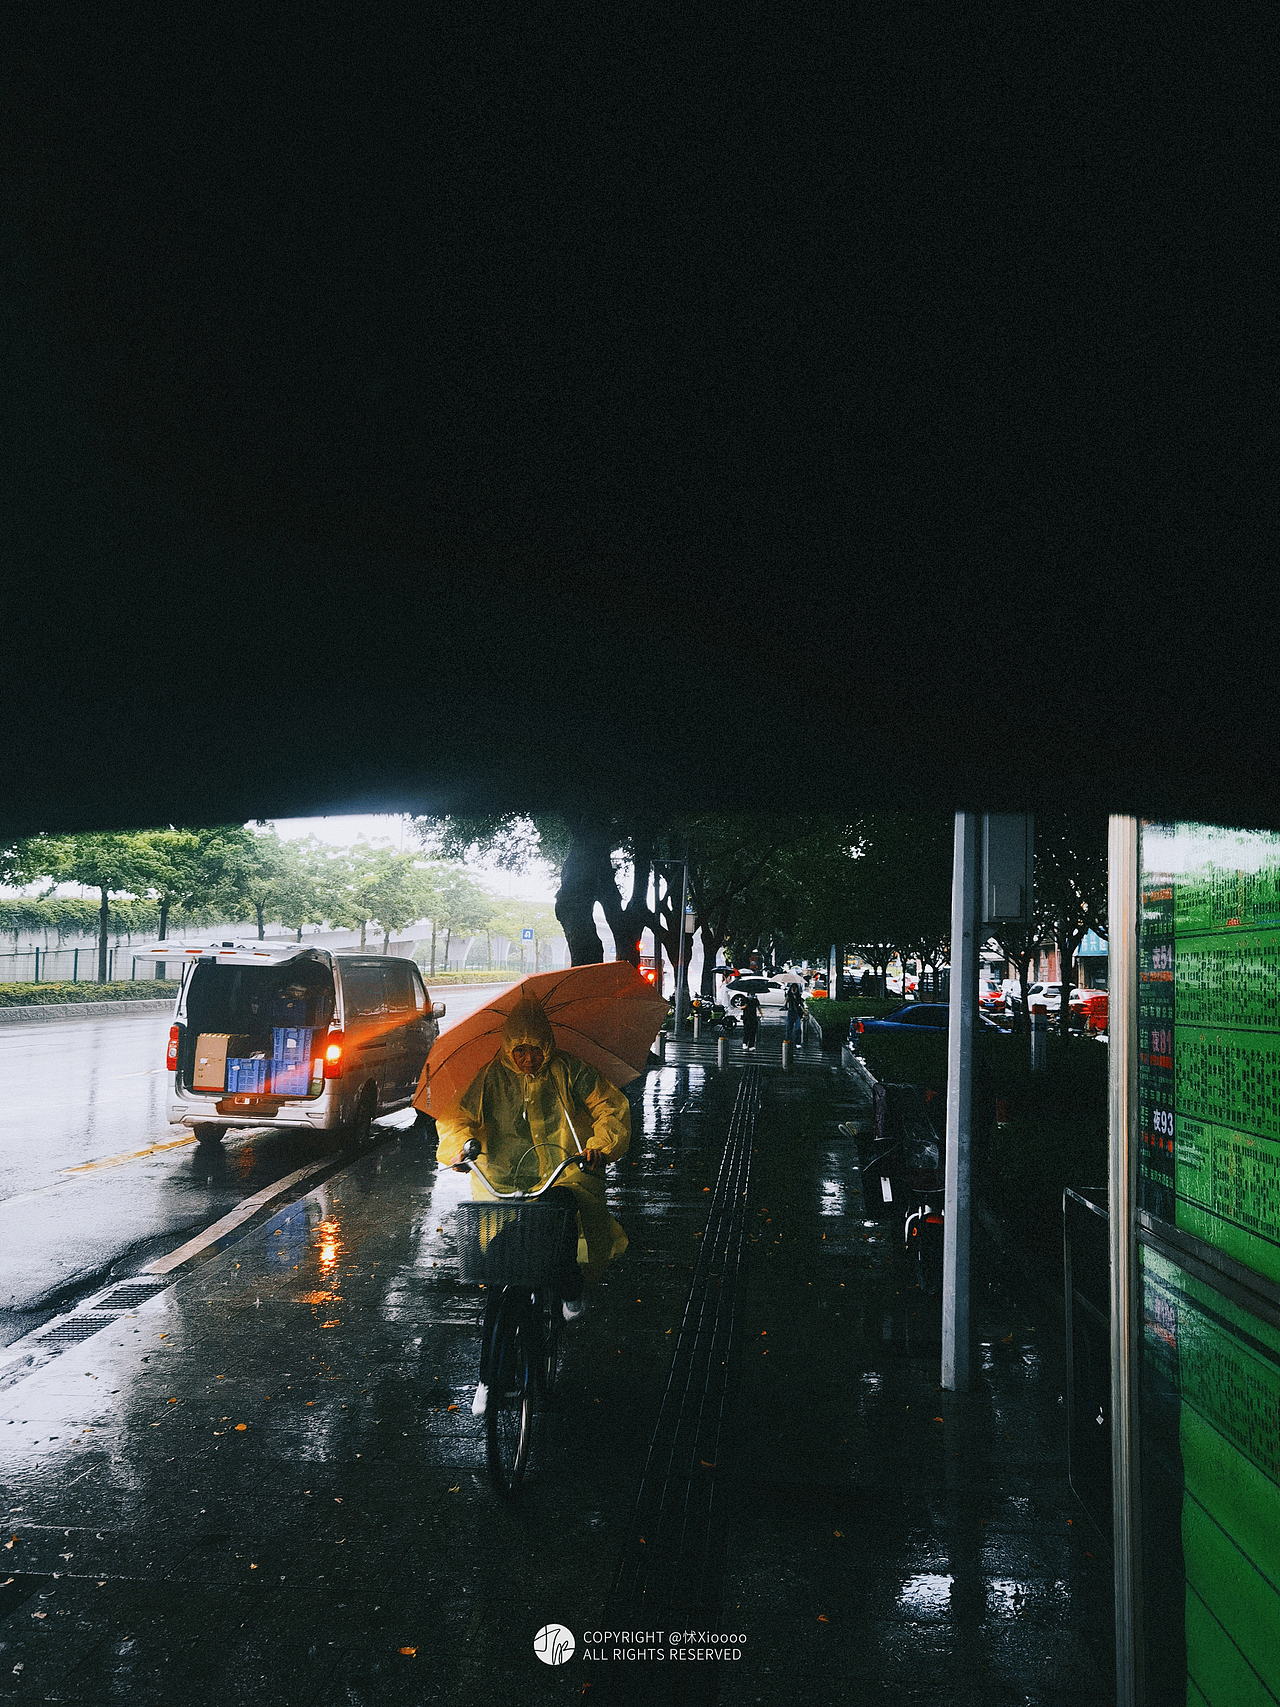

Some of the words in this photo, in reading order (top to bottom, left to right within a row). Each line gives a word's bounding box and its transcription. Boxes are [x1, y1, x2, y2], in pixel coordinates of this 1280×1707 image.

[1152, 945, 1172, 970] 夜51
[1151, 1029, 1171, 1055] 夜81
[1153, 1108, 1174, 1137] 夜93
